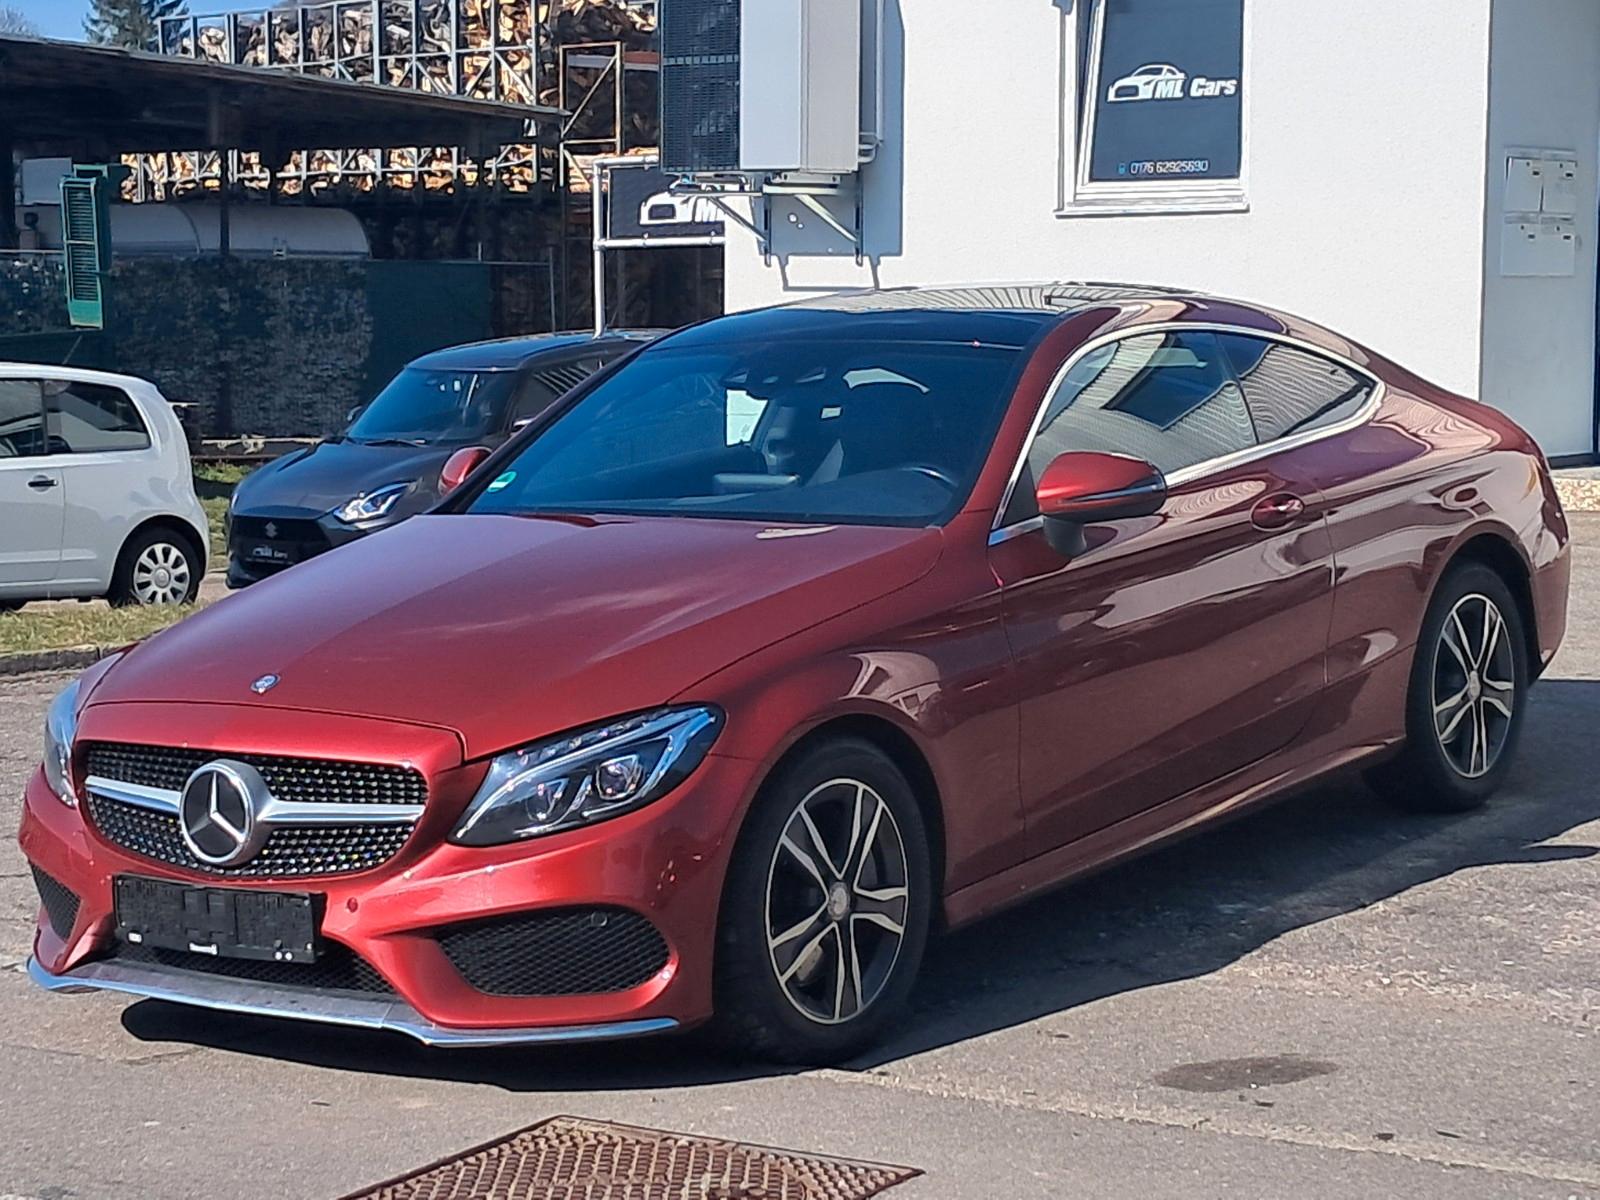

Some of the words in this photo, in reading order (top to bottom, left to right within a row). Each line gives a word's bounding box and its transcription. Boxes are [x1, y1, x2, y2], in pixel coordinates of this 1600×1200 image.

[1153, 78, 1185, 99] ML
[1190, 77, 1238, 97] Cars
[1130, 161, 1155, 174] 0176
